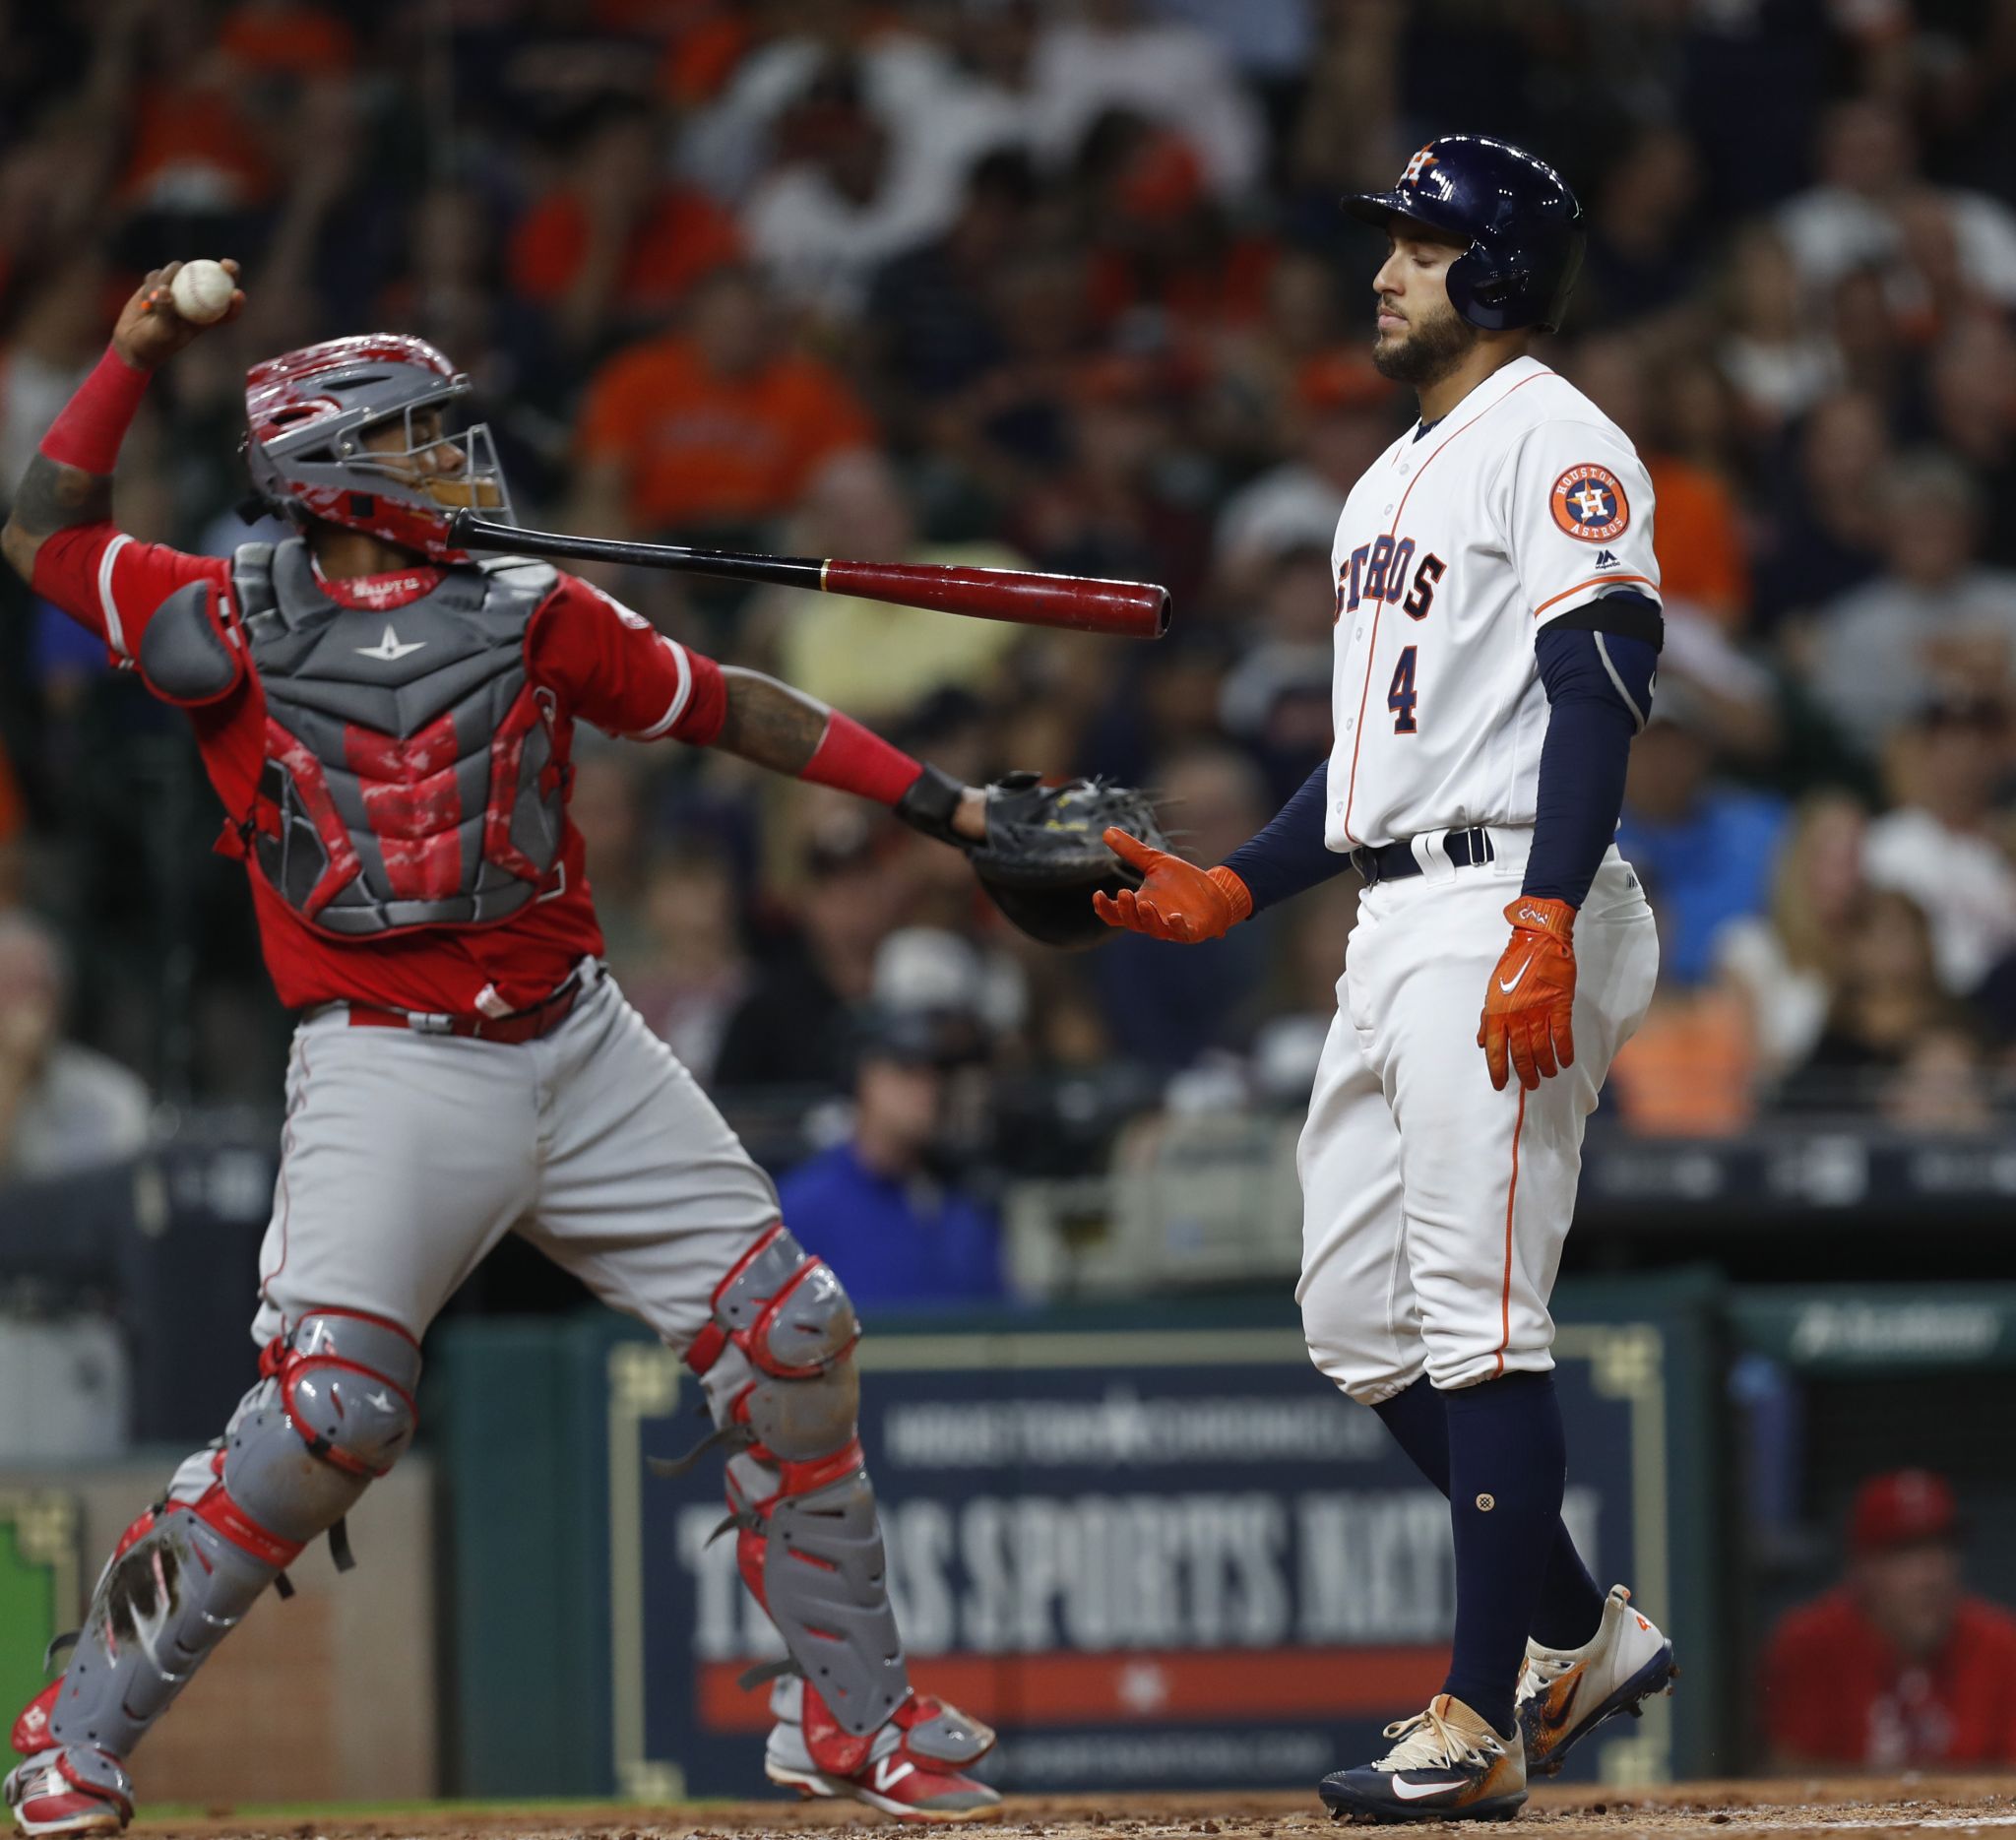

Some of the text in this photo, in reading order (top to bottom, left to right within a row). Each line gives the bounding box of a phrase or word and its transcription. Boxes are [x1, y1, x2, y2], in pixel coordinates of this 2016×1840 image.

[1556, 468, 1615, 494] HOUSTON
[1570, 517, 1623, 538] ASTROS
[1387, 645, 1418, 734] 4
